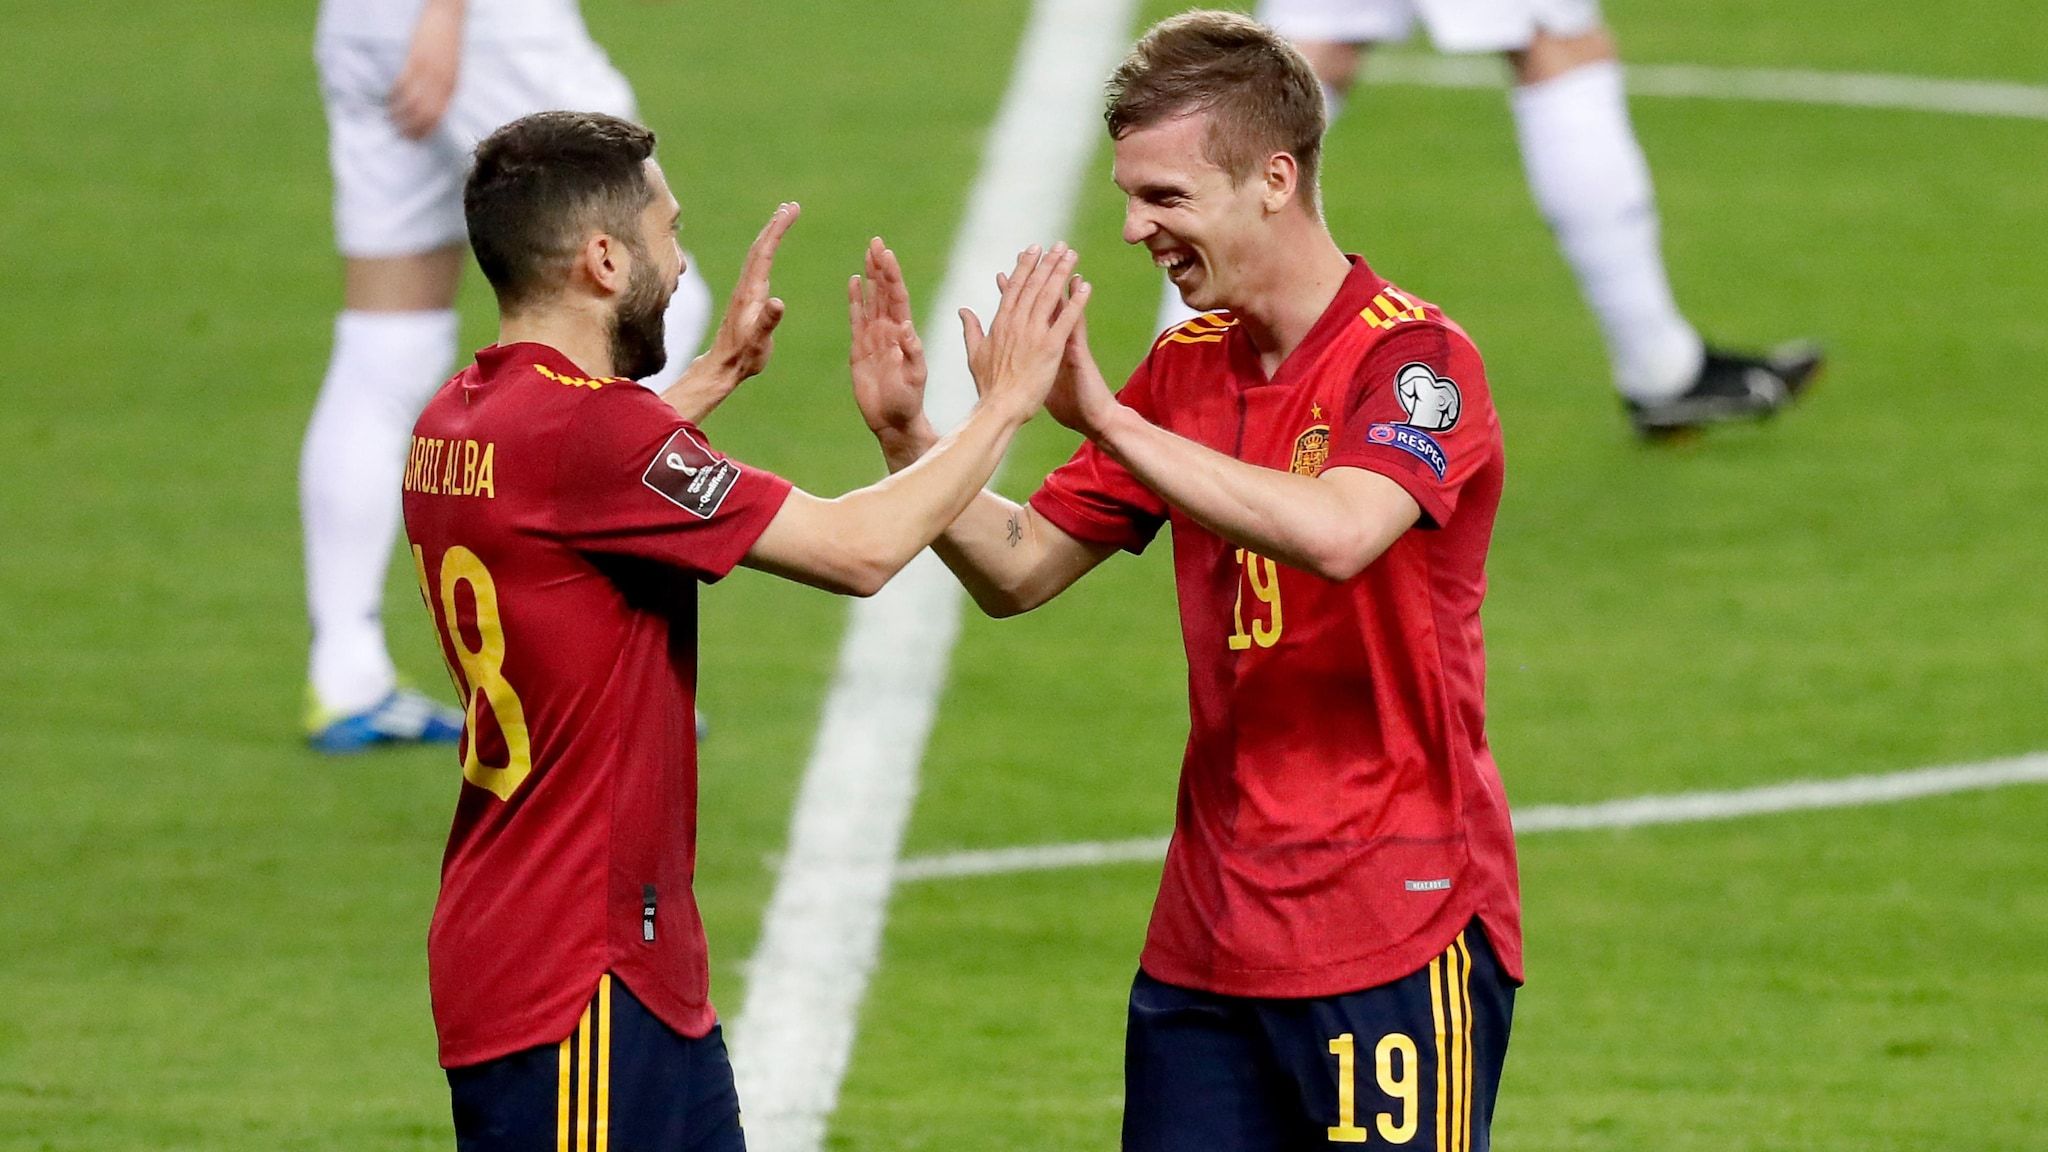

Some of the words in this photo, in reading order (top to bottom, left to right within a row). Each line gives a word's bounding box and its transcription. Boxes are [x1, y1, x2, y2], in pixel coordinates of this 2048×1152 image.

[443, 440, 494, 498] ALBA
[1397, 431, 1446, 476] RESPECT
[1228, 548, 1283, 650] 19
[1327, 1033, 1418, 1144] 19
